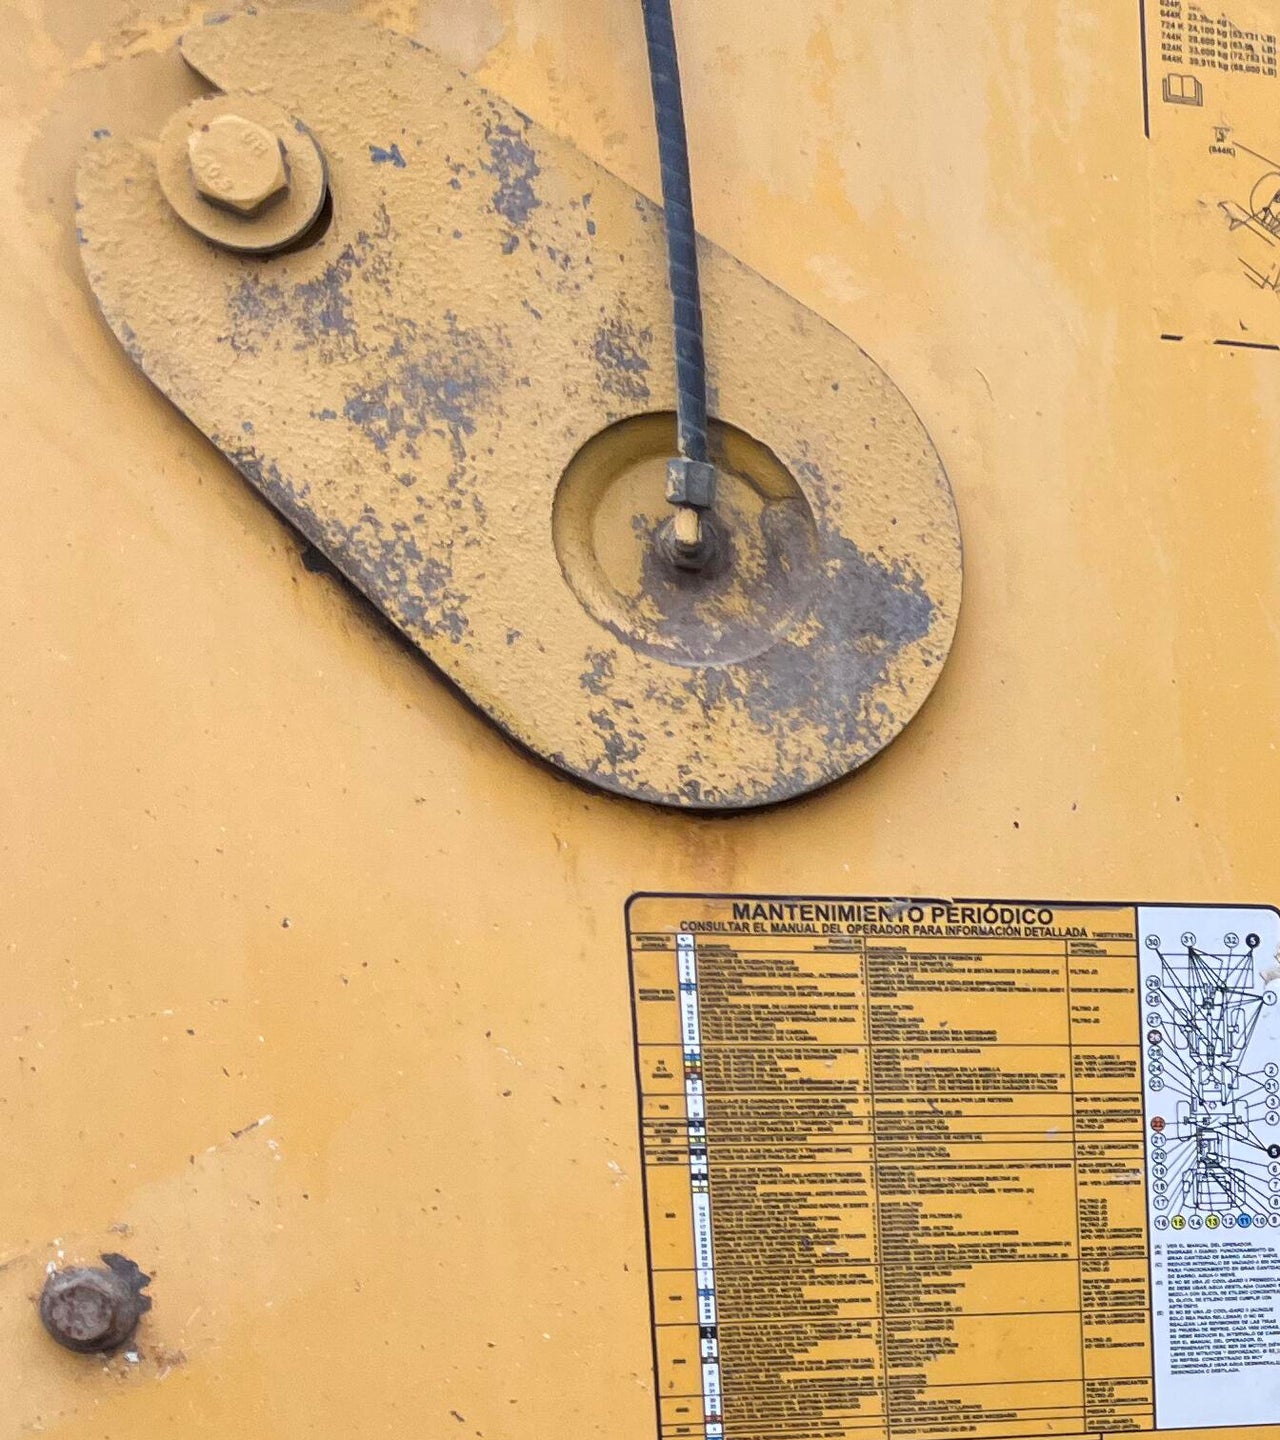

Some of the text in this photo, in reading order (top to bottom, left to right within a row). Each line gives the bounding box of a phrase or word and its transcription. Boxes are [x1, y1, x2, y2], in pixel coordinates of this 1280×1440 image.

[931, 905, 1054, 925] PERIÓDICO
[680, 920, 750, 933] CONSULTAR
[753, 922, 767, 933] EL
[770, 922, 819, 934] MANUAL
[822, 923, 843, 934] DEL
[846, 923, 910, 935] OPERADOR
[912, 924, 943, 936] PARA
[945, 924, 1021, 937] INFORMACIÓN
[1024, 925, 1088, 938] DETALLADA
